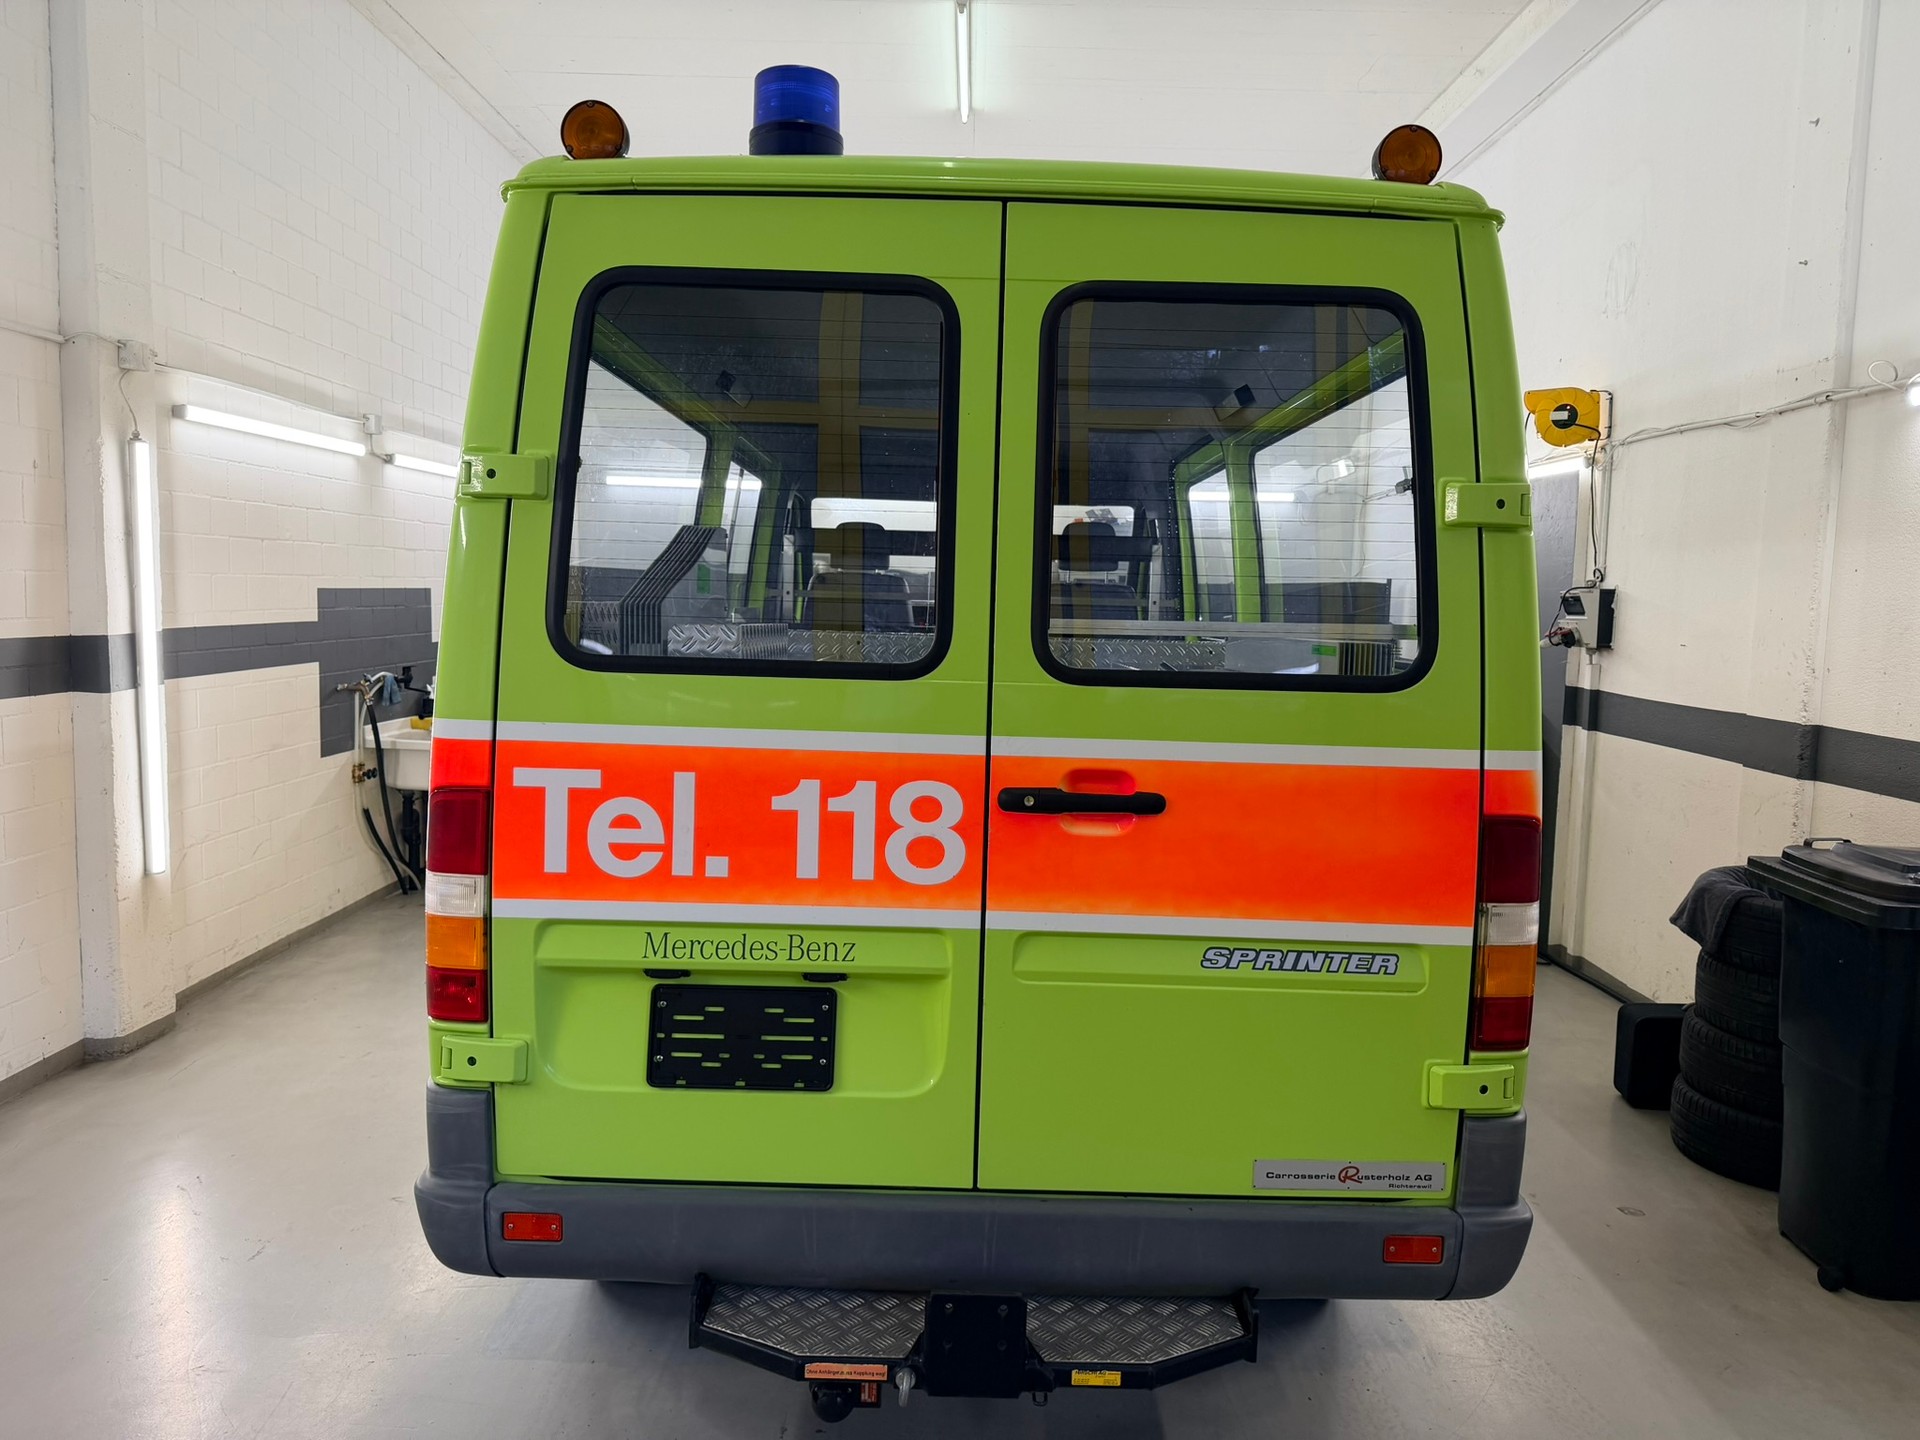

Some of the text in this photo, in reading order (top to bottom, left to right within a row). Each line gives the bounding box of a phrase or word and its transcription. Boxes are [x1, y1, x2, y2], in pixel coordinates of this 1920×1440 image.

[513, 767, 966, 885] Tel. 118
[642, 932, 857, 962] Mercedes-Benz
[1201, 946, 1399, 976] SPRINTER
[1265, 1166, 1433, 1185] Carrosserie Rusterholz AG
